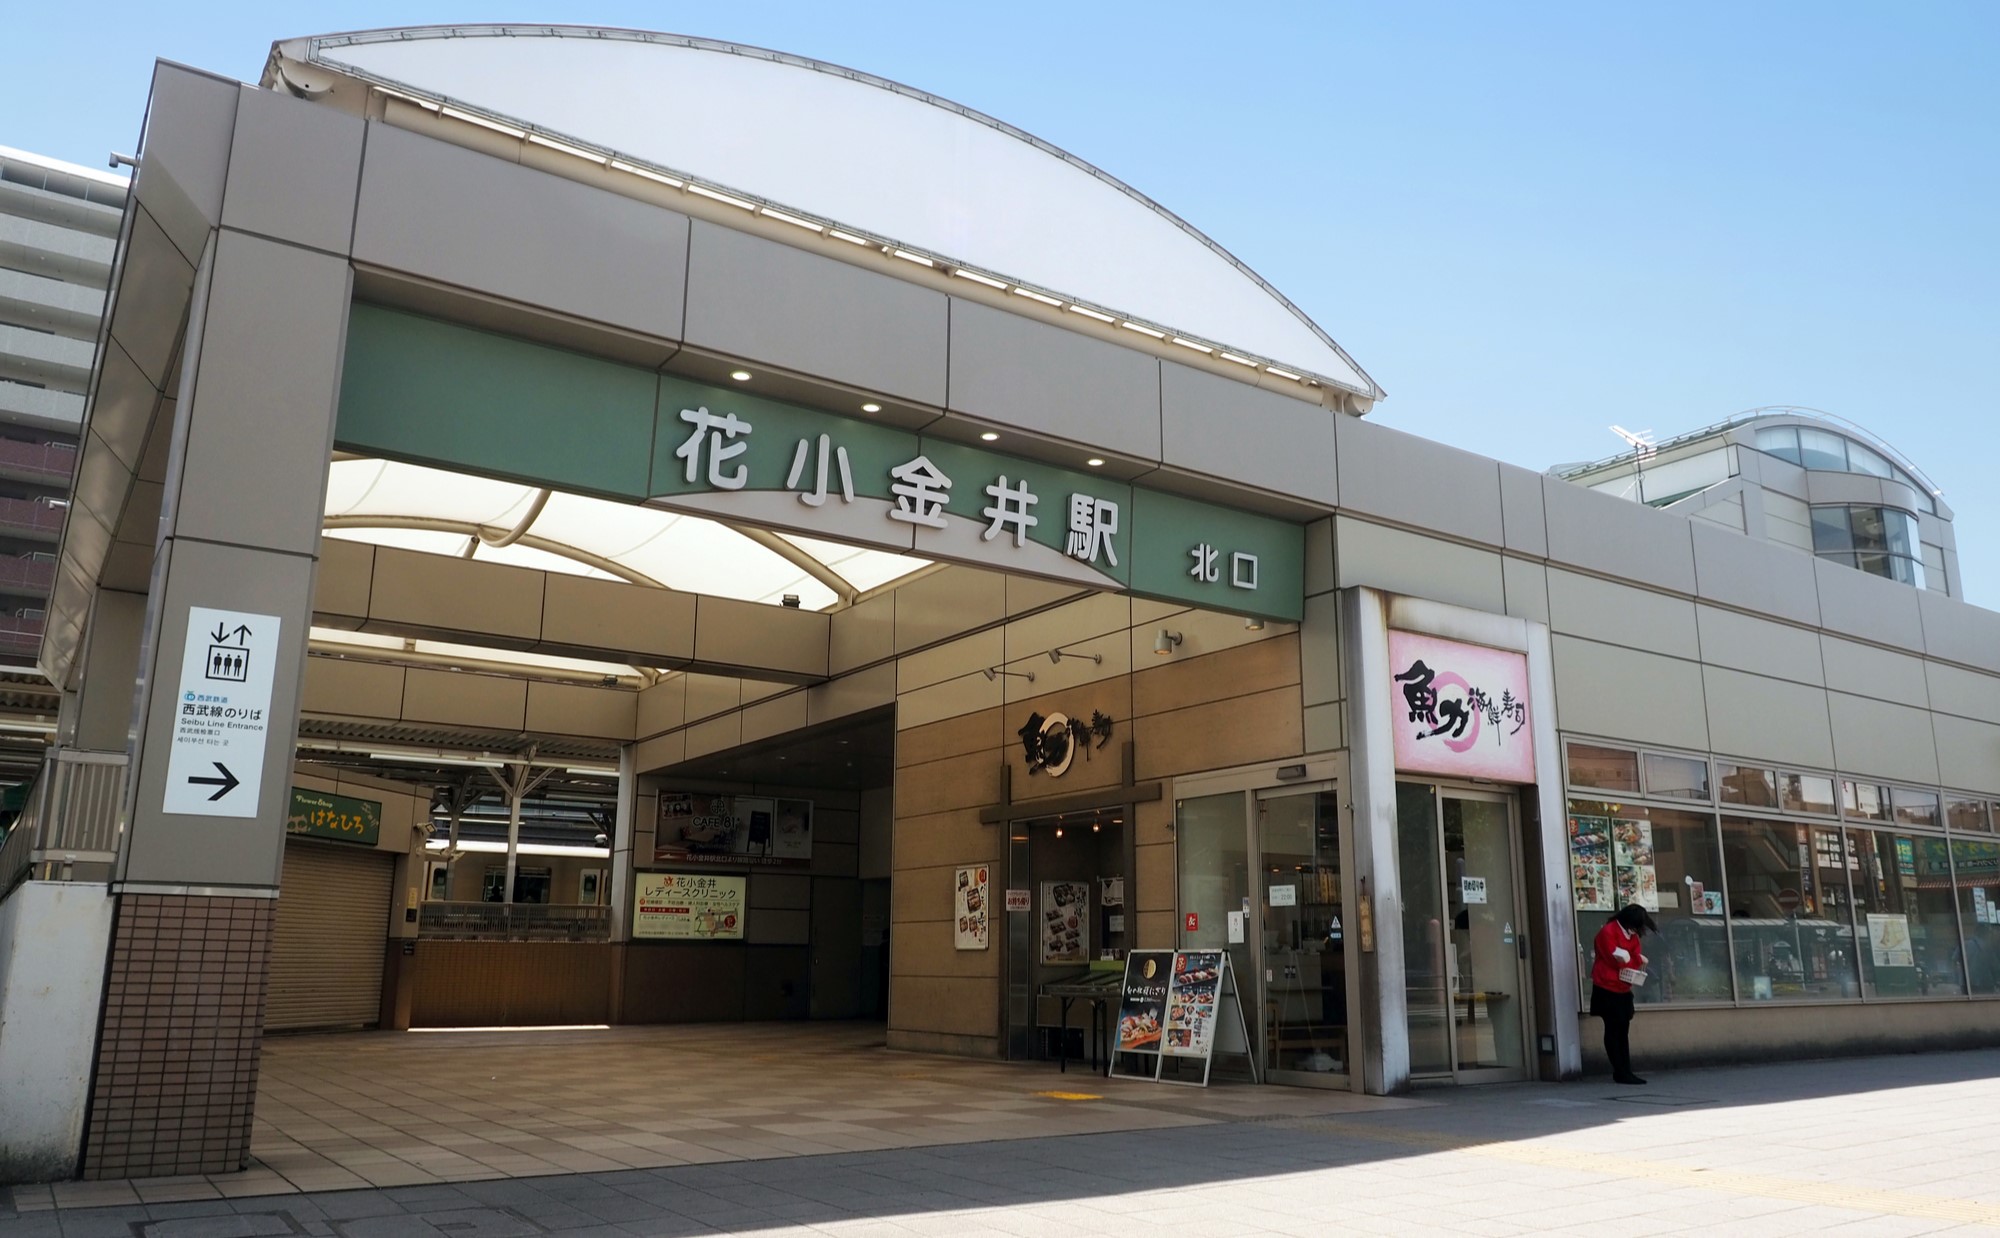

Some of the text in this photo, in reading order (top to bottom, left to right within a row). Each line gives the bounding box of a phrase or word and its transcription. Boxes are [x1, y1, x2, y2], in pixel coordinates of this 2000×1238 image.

[676, 406, 1259, 591] 花小金井駅 北口
[197, 695, 228, 704] 西武鉄道
[1394, 660, 1469, 740] 魚力
[182, 703, 263, 721] 西武線のりば
[181, 717, 264, 731] Seibu Line Entrance
[318, 798, 333, 809] Shop
[310, 809, 364, 834] はなひろ
[692, 816, 721, 828] CAFE
[676, 877, 717, 889] 花小金井
[645, 886, 736, 899] レディースクリニック
